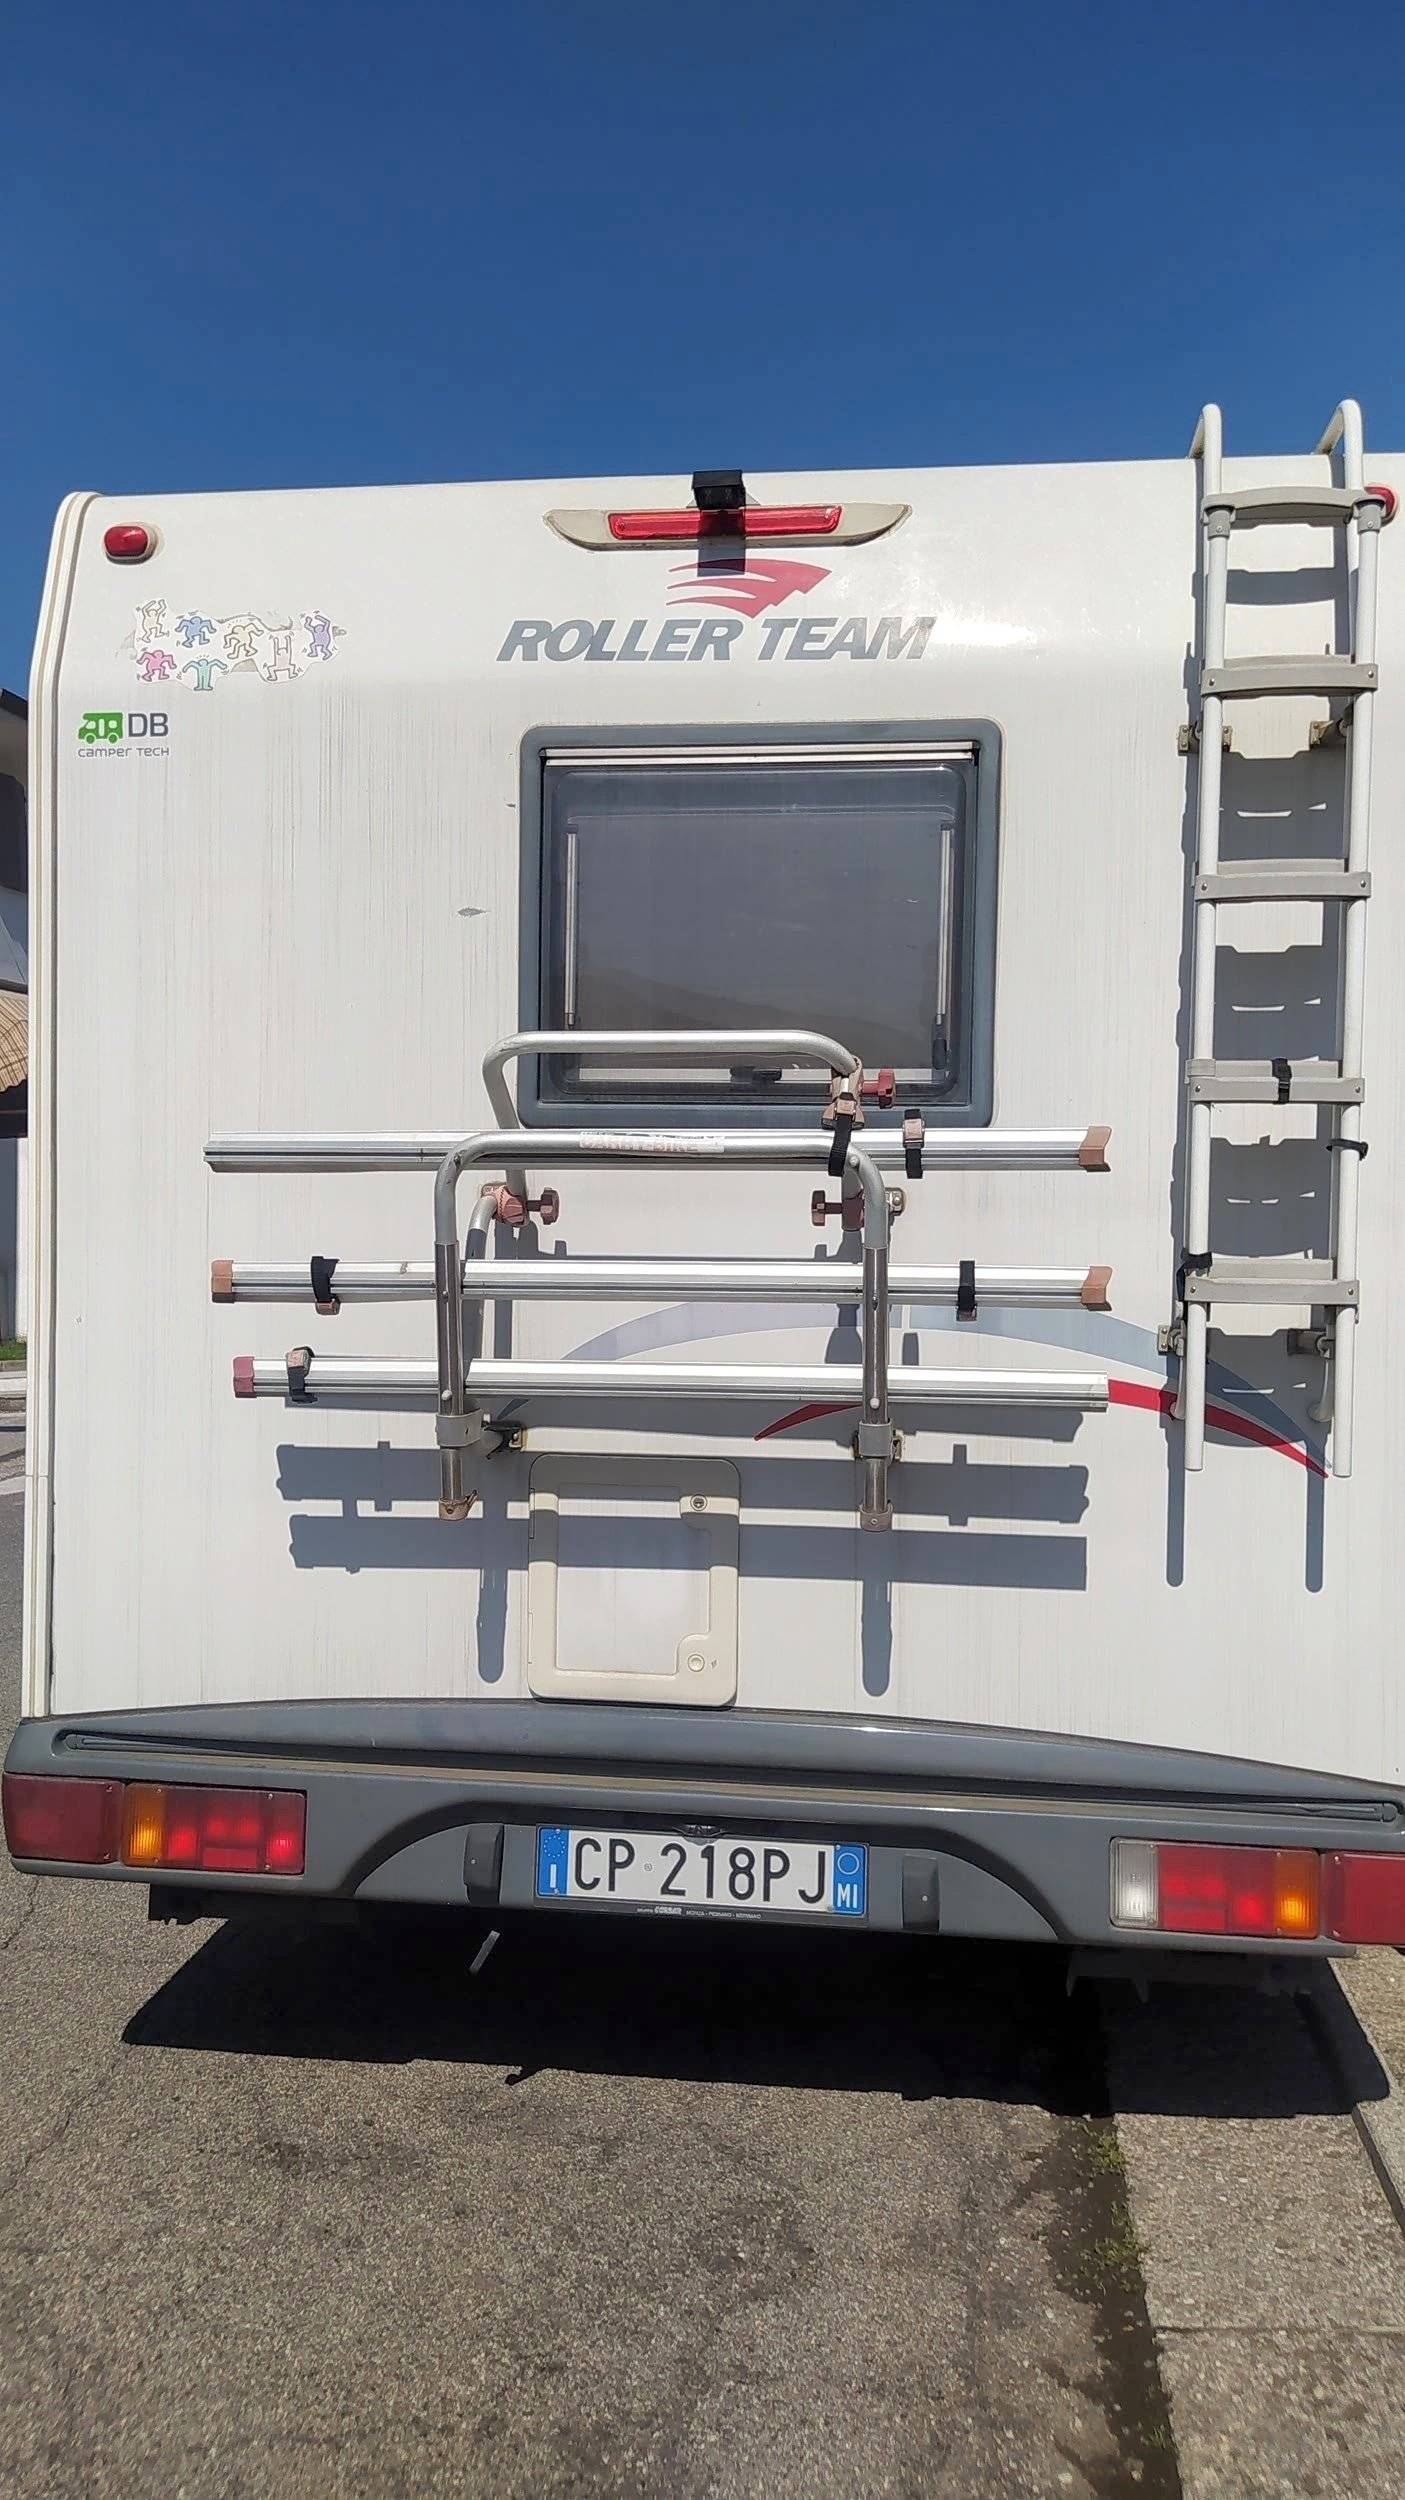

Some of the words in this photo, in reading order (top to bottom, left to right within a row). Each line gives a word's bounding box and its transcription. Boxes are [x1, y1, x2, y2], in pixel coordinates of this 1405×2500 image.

[496, 619, 744, 662] ROLLER
[757, 616, 938, 661] TEAM
[127, 712, 169, 738] DB
[77, 747, 132, 759] camper
[574, 1837, 636, 1892] CP
[660, 1842, 827, 1905] 218PJ
[836, 1883, 858, 1909] MI
